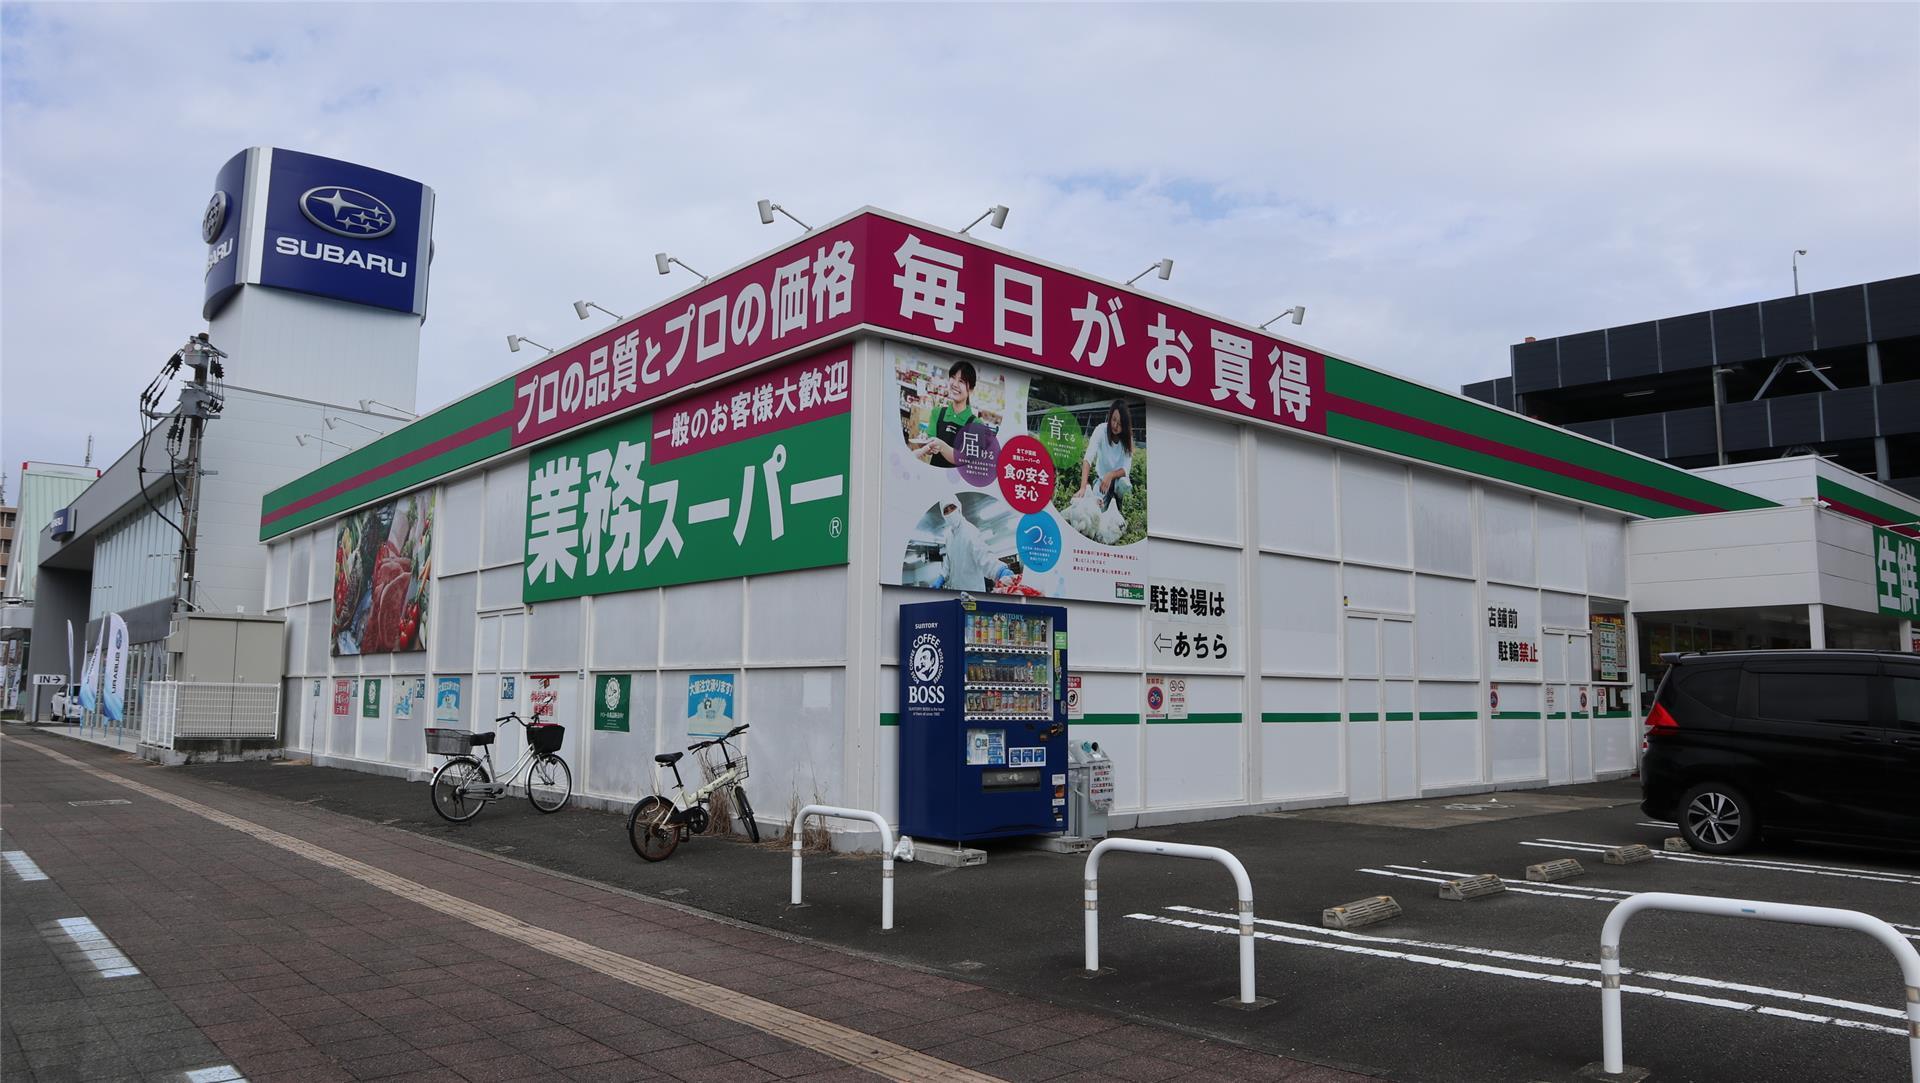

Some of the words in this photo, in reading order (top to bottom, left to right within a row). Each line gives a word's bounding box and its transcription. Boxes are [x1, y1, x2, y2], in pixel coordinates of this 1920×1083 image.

[276, 236, 407, 278] SUBARU
[517, 240, 855, 434] プロの品質とプロの価格
[893, 233, 1311, 422] 毎日がお買得
[653, 359, 849, 447] 一般のお客様大歓迎
[1048, 415, 1075, 442] 育てる
[960, 432, 994, 460] 届ける
[1004, 463, 1049, 486] 食の安全
[1014, 484, 1039, 502] 安心
[526, 440, 843, 586] 業務スーパー
[1024, 525, 1054, 546] つくる
[1877, 534, 1919, 615] 生鮮
[1149, 585, 1226, 617] 駐輪場は
[914, 622, 939, 630] SUNTORY
[912, 633, 941, 649] COFFEE
[1174, 631, 1228, 660] あちら
[1498, 641, 1539, 663] 駐輪禁止
[39, 675, 51, 684] IN
[908, 685, 945, 704] BOSS
